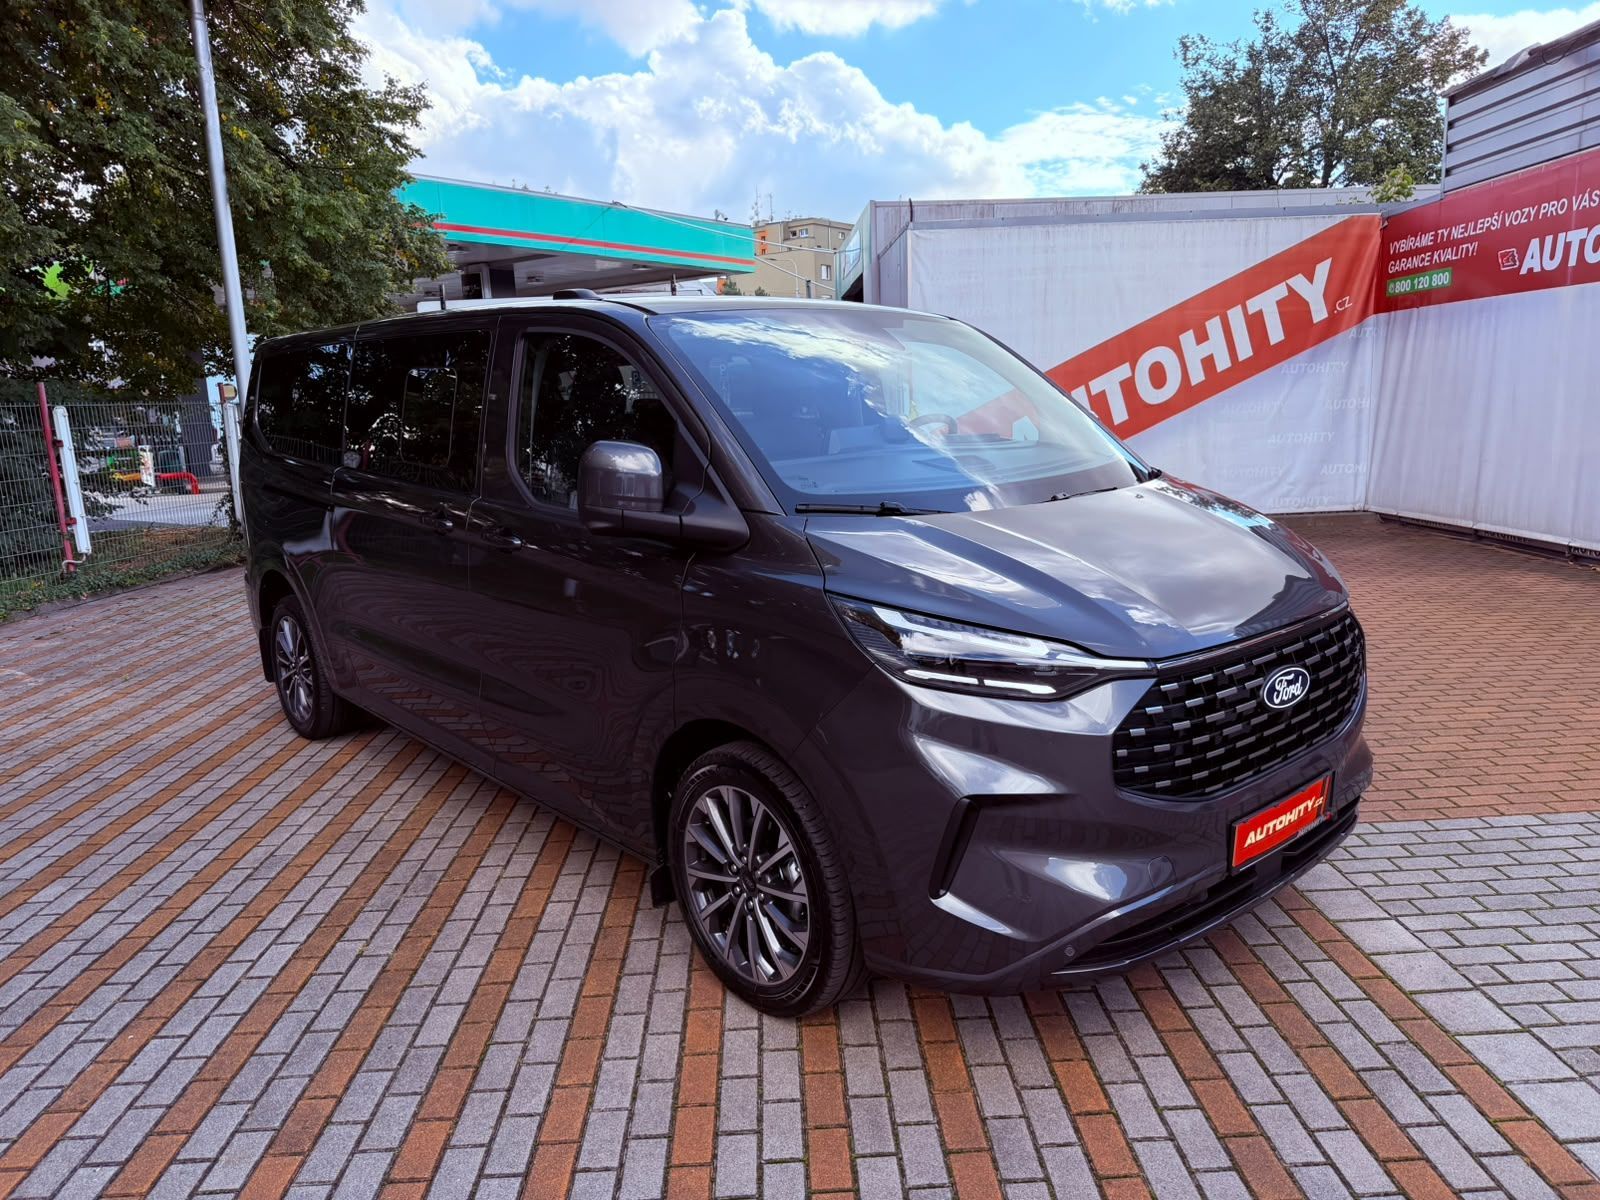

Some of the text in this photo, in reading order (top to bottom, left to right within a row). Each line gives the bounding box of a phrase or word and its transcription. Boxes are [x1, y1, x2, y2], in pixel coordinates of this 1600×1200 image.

[1389, 188, 1600, 255] VYBÍRÁME TY NEJLEPŠÍ VOZY PRO VÁS
[1388, 241, 1479, 274] GARANCE KVALITY!
[1394, 271, 1450, 293] 800 120 800
[1280, 360, 1350, 375] AUTOHITY
[1267, 431, 1335, 444] AUTOHITY
[1273, 672, 1303, 705] Ford
